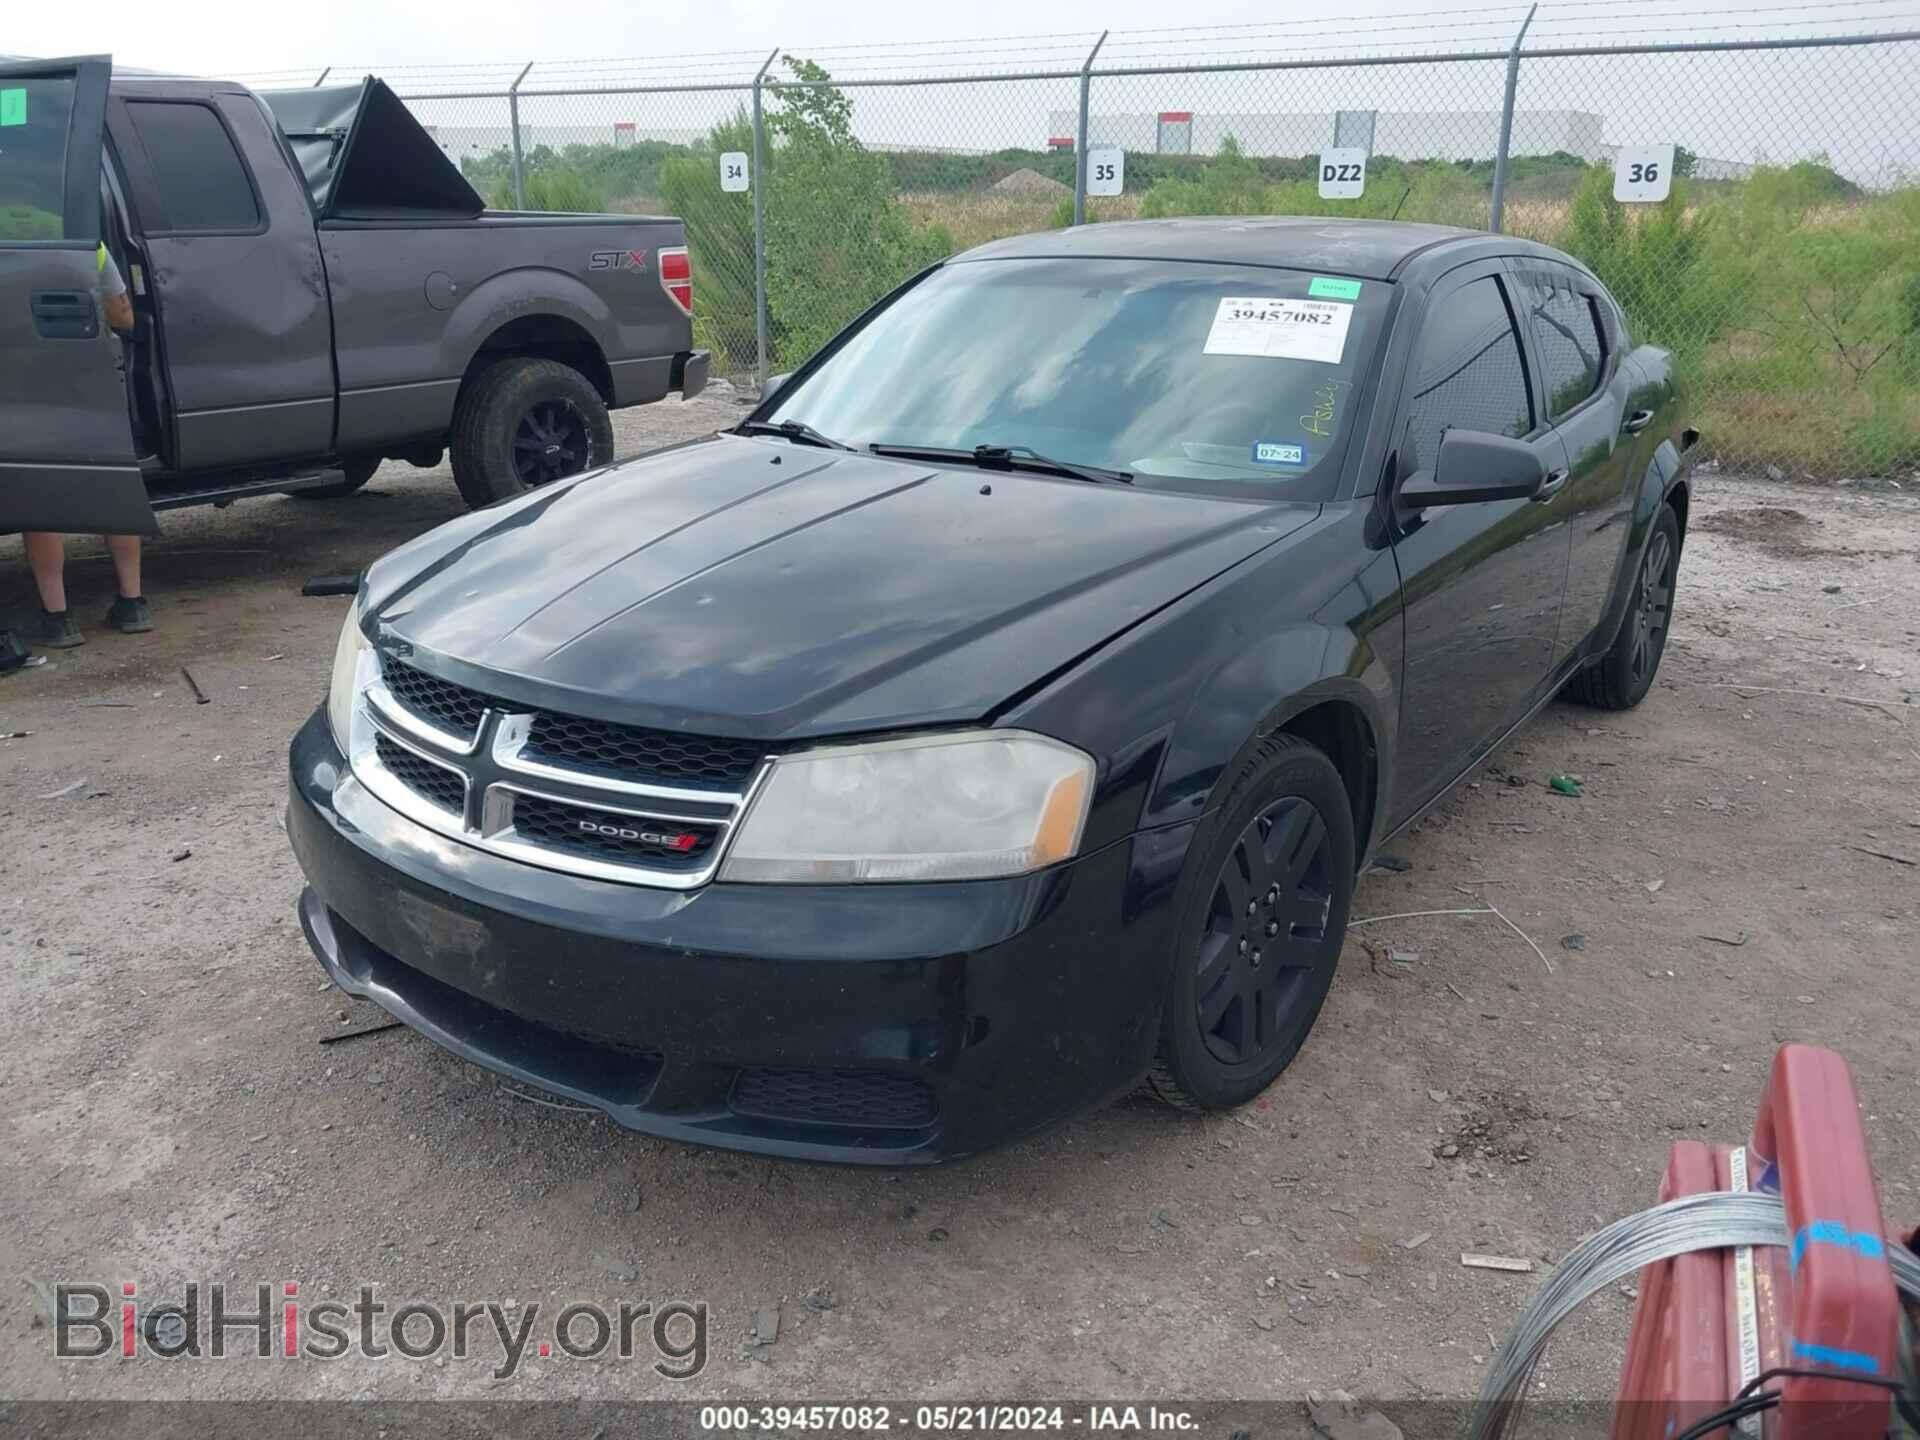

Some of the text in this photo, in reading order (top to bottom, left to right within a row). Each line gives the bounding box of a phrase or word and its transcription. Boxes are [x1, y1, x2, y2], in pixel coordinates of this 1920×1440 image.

[727, 165, 742, 179] 34
[1095, 164, 1115, 181] 35
[1322, 164, 1362, 182] DZ2
[1628, 162, 1659, 183] 36
[589, 249, 648, 271] STX
[1227, 308, 1333, 326] 39457082
[1260, 448, 1300, 460] 07-24
[579, 820, 681, 846] DODGE
